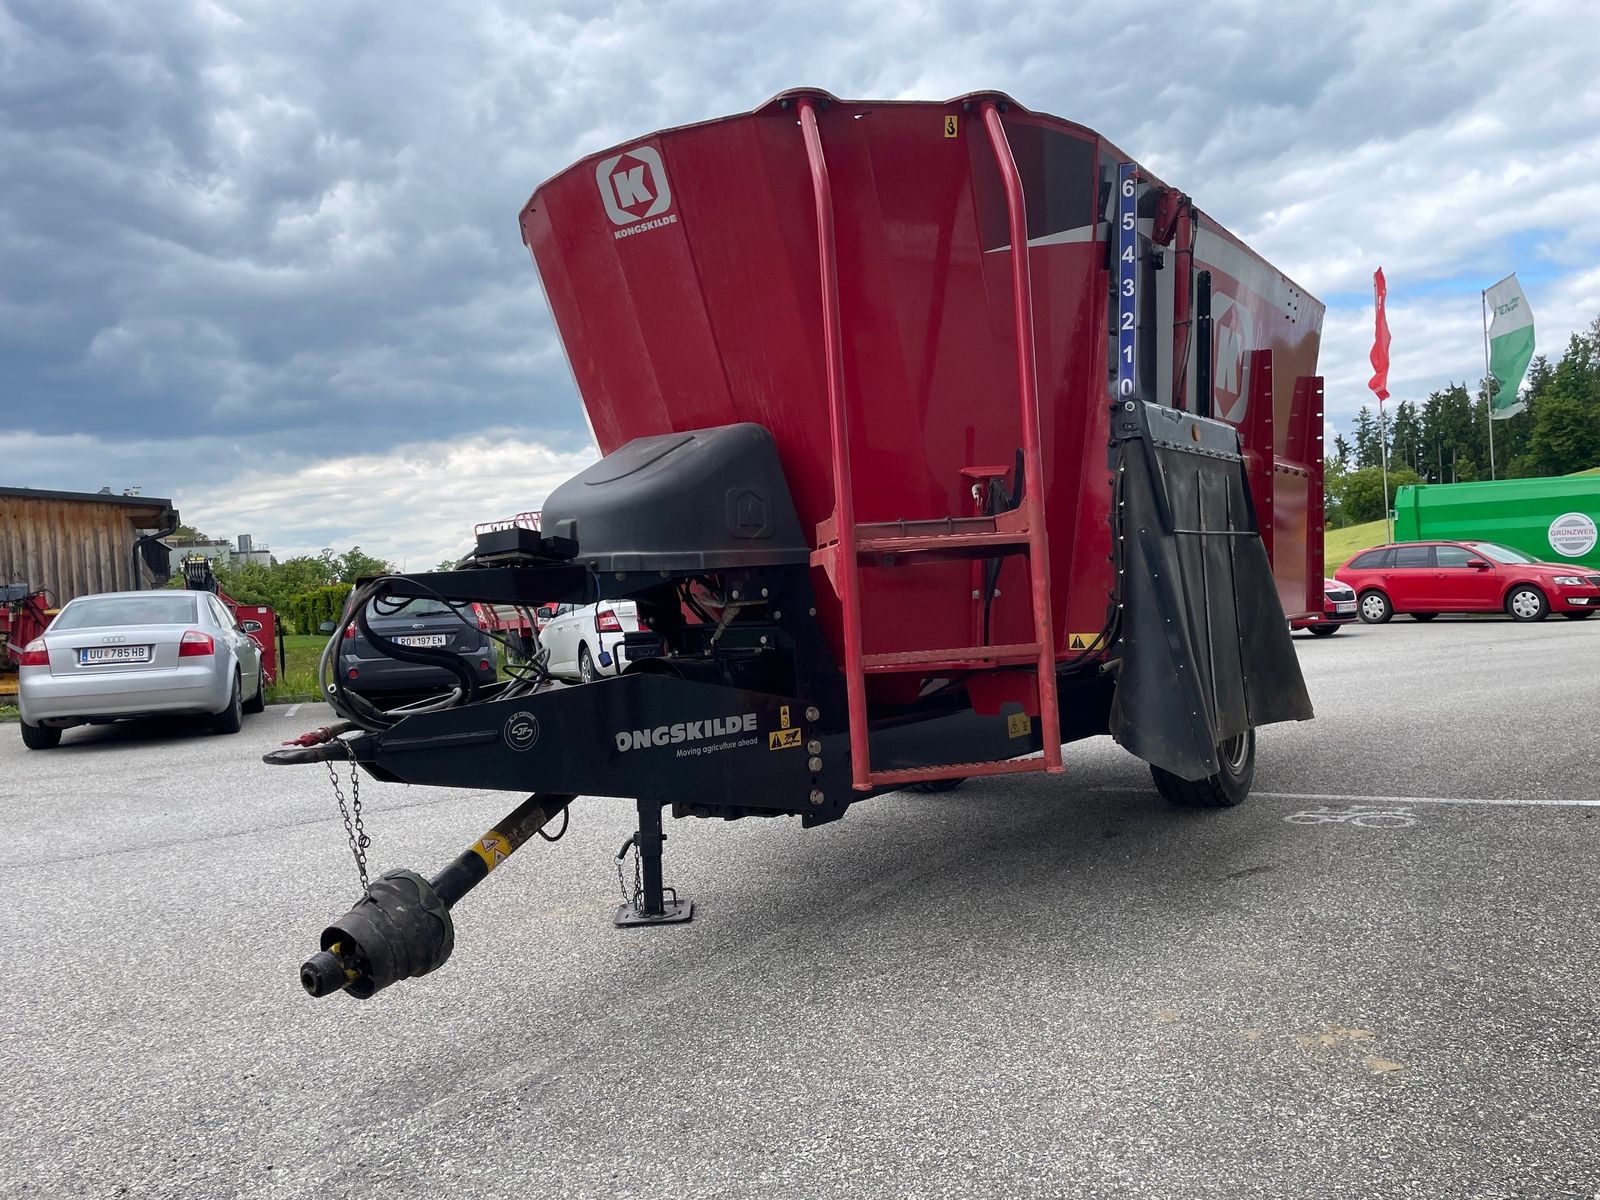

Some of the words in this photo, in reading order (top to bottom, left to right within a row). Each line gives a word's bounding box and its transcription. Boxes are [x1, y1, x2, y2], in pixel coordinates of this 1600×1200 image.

[613, 165, 653, 208] K
[1122, 180, 1135, 198] 6
[614, 214, 677, 239] KONGSKILDE
[1122, 212, 1135, 230] 5
[1121, 245, 1135, 264] 4
[1122, 279, 1135, 297] 3
[1121, 312, 1134, 330] 2
[1123, 345, 1133, 363] 1
[1120, 379, 1133, 396] 0
[1550, 528, 1596, 536] GRÜNZWEIL
[417, 636, 431, 645] 197
[432, 636, 443, 644] EN
[90, 650, 103, 659] UU
[111, 648, 130, 657] 785
[132, 647, 144, 656] HB
[676, 747, 702, 758] Moving
[702, 740, 737, 755] agriculture
[738, 736, 758, 747] ahead
